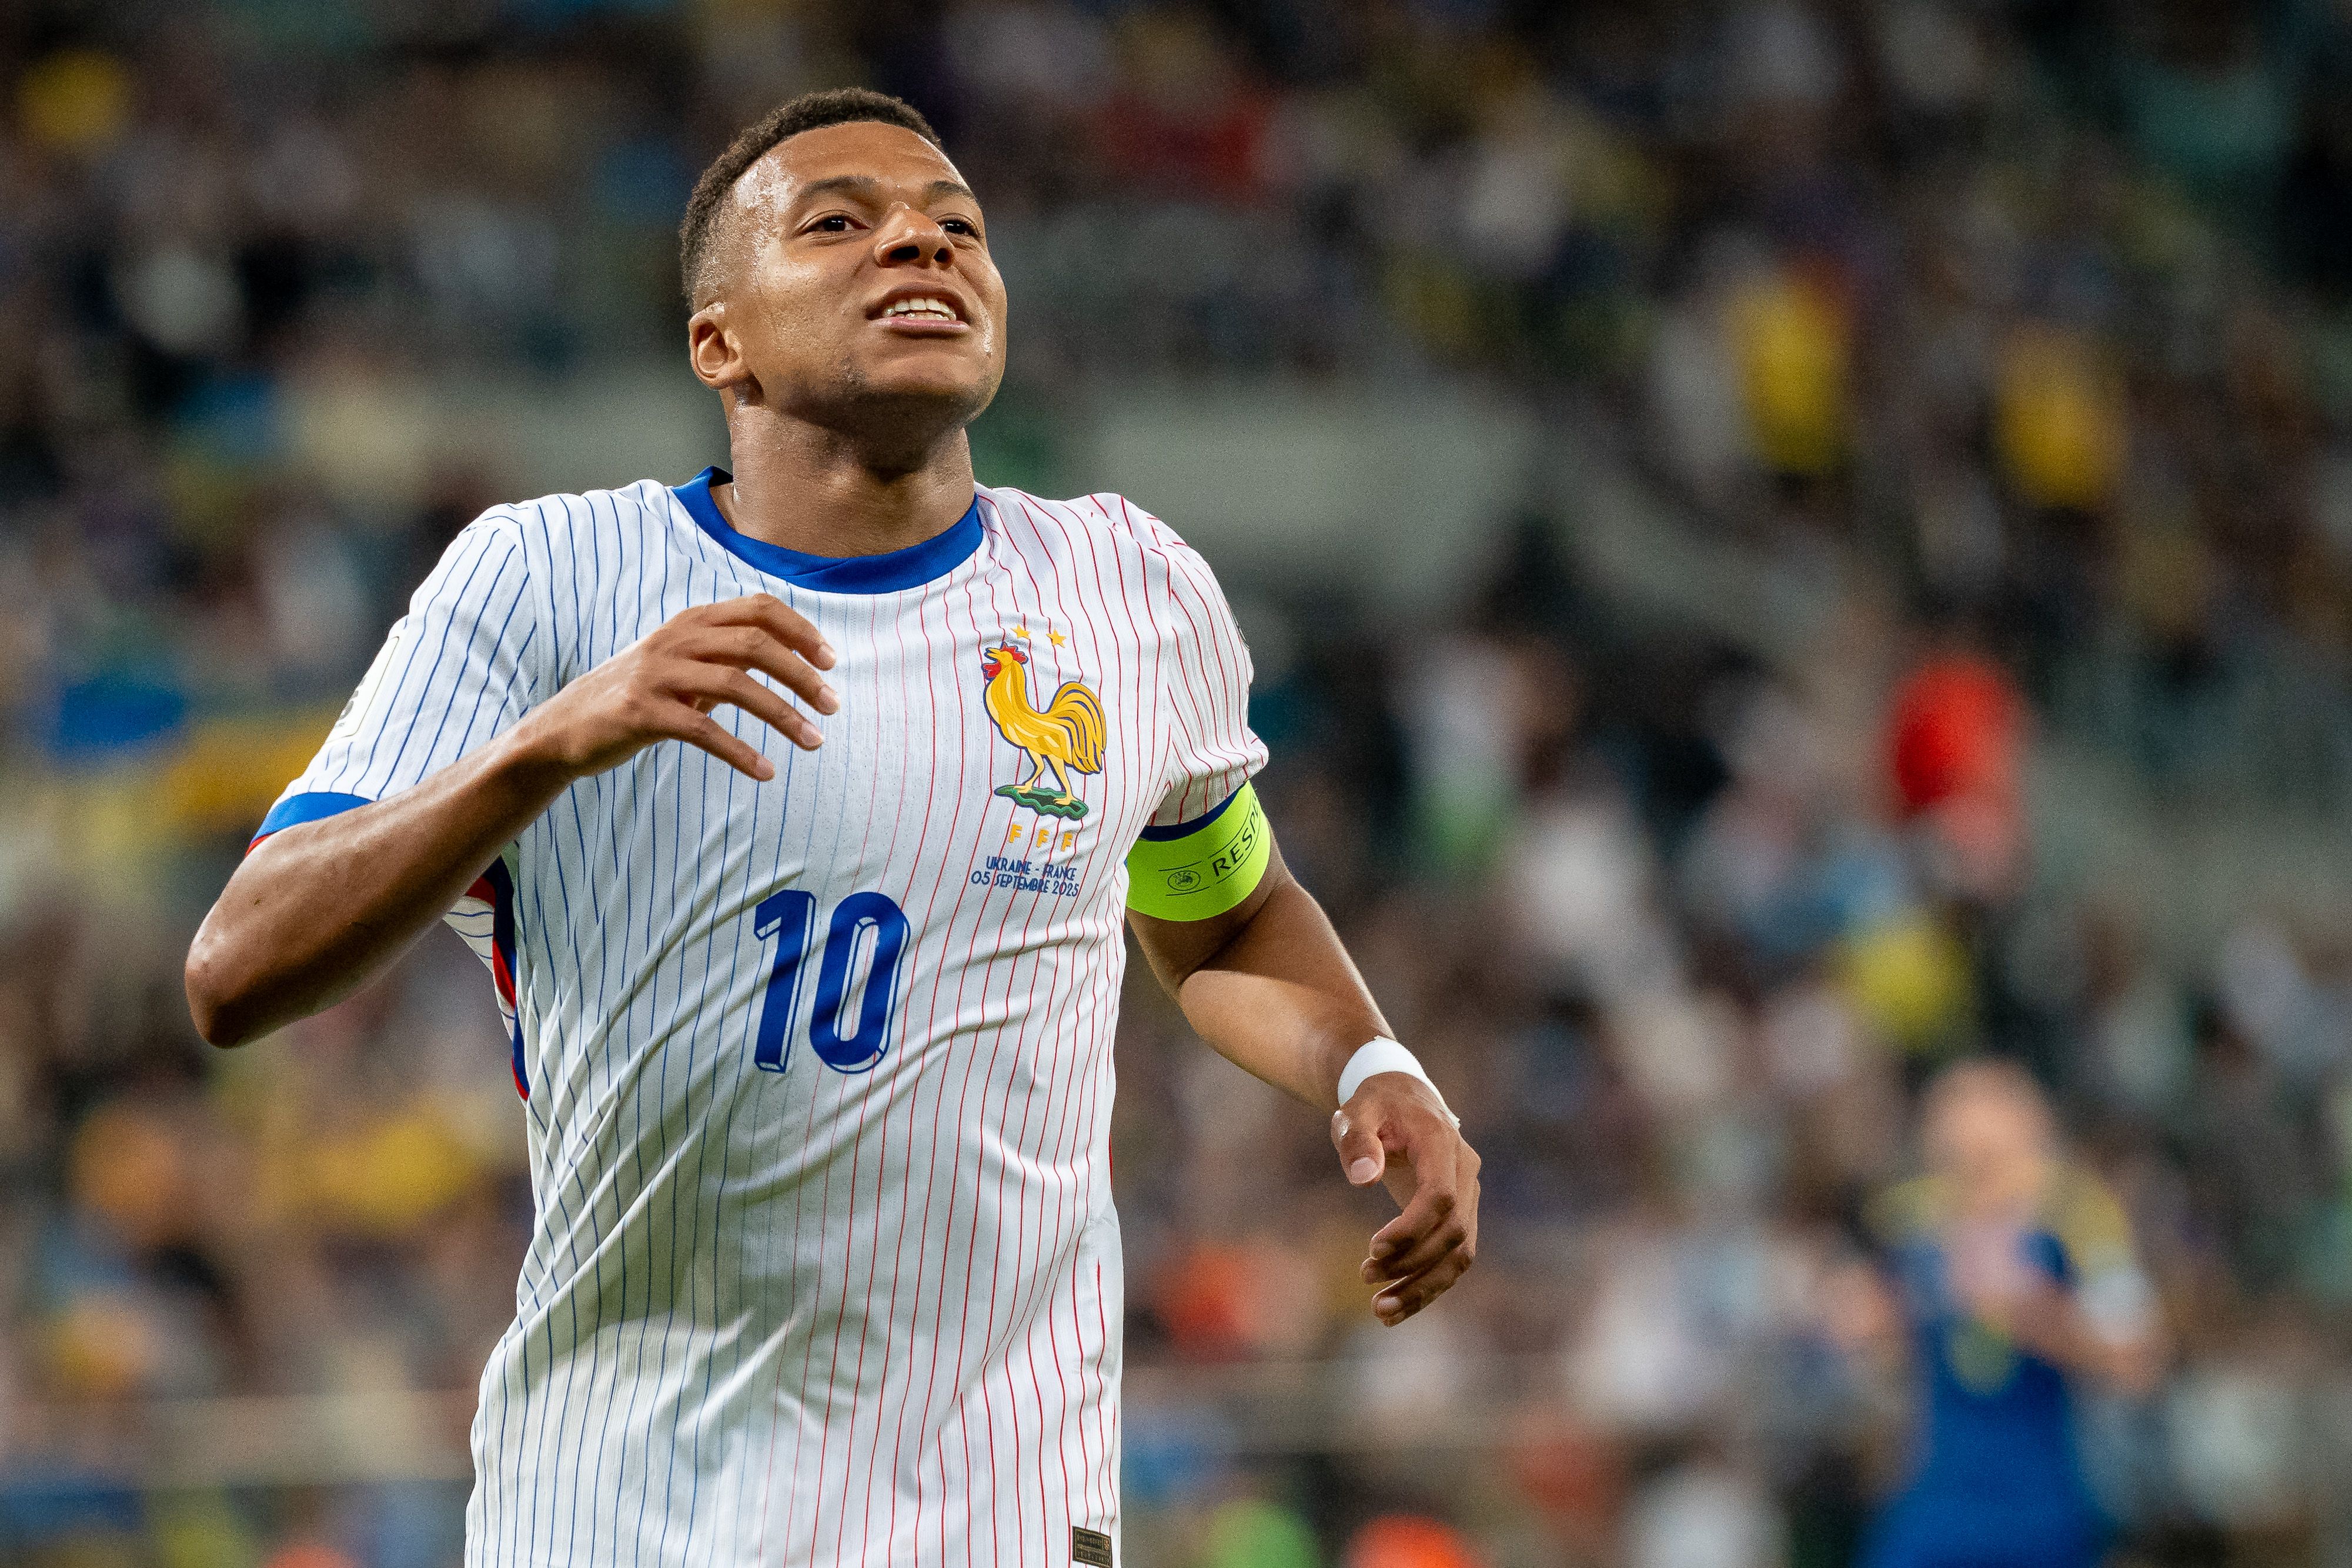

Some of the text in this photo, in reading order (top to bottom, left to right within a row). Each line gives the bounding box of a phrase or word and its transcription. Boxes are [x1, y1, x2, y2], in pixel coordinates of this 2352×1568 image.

[986, 856, 1032, 875] UKRAINE
[1043, 864, 1077, 881] FRANCE
[971, 871, 1080, 897] 05 SEPTEMBRE 2025
[754, 890, 911, 1074] 10
